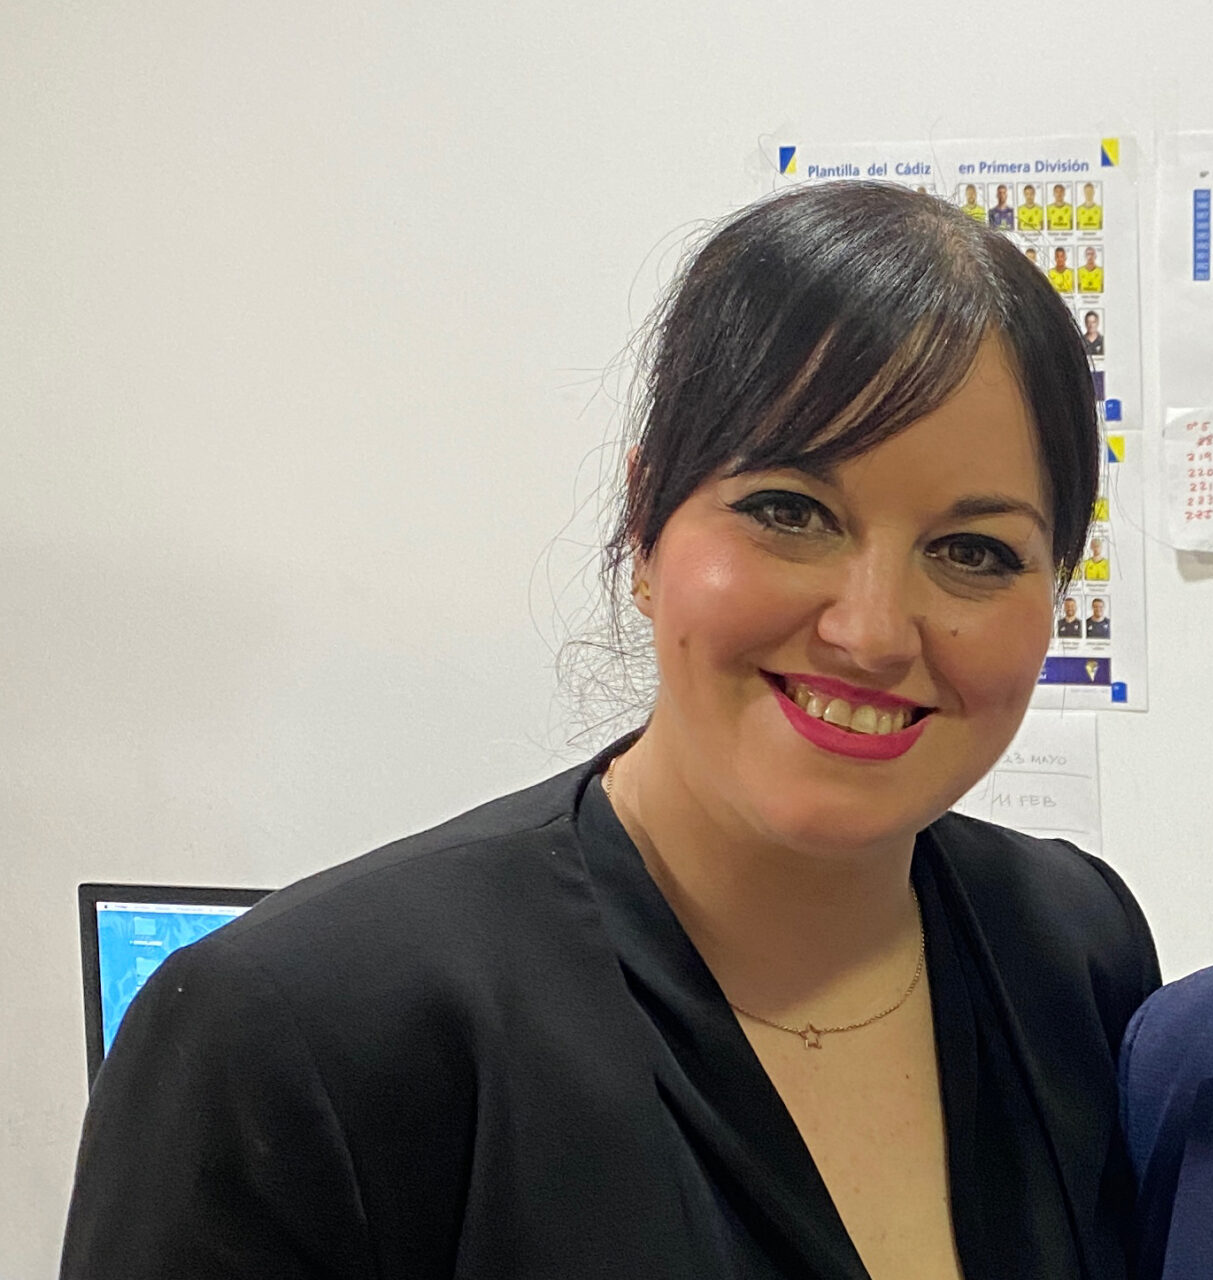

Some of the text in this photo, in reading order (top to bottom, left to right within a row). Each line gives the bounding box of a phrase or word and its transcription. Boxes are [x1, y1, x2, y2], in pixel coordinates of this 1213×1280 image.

[807, 159, 1090, 177] Plantilla del Cádiz en Primera División
[1031, 755, 1068, 766] MAYO
[1020, 795, 1057, 808] FEB
